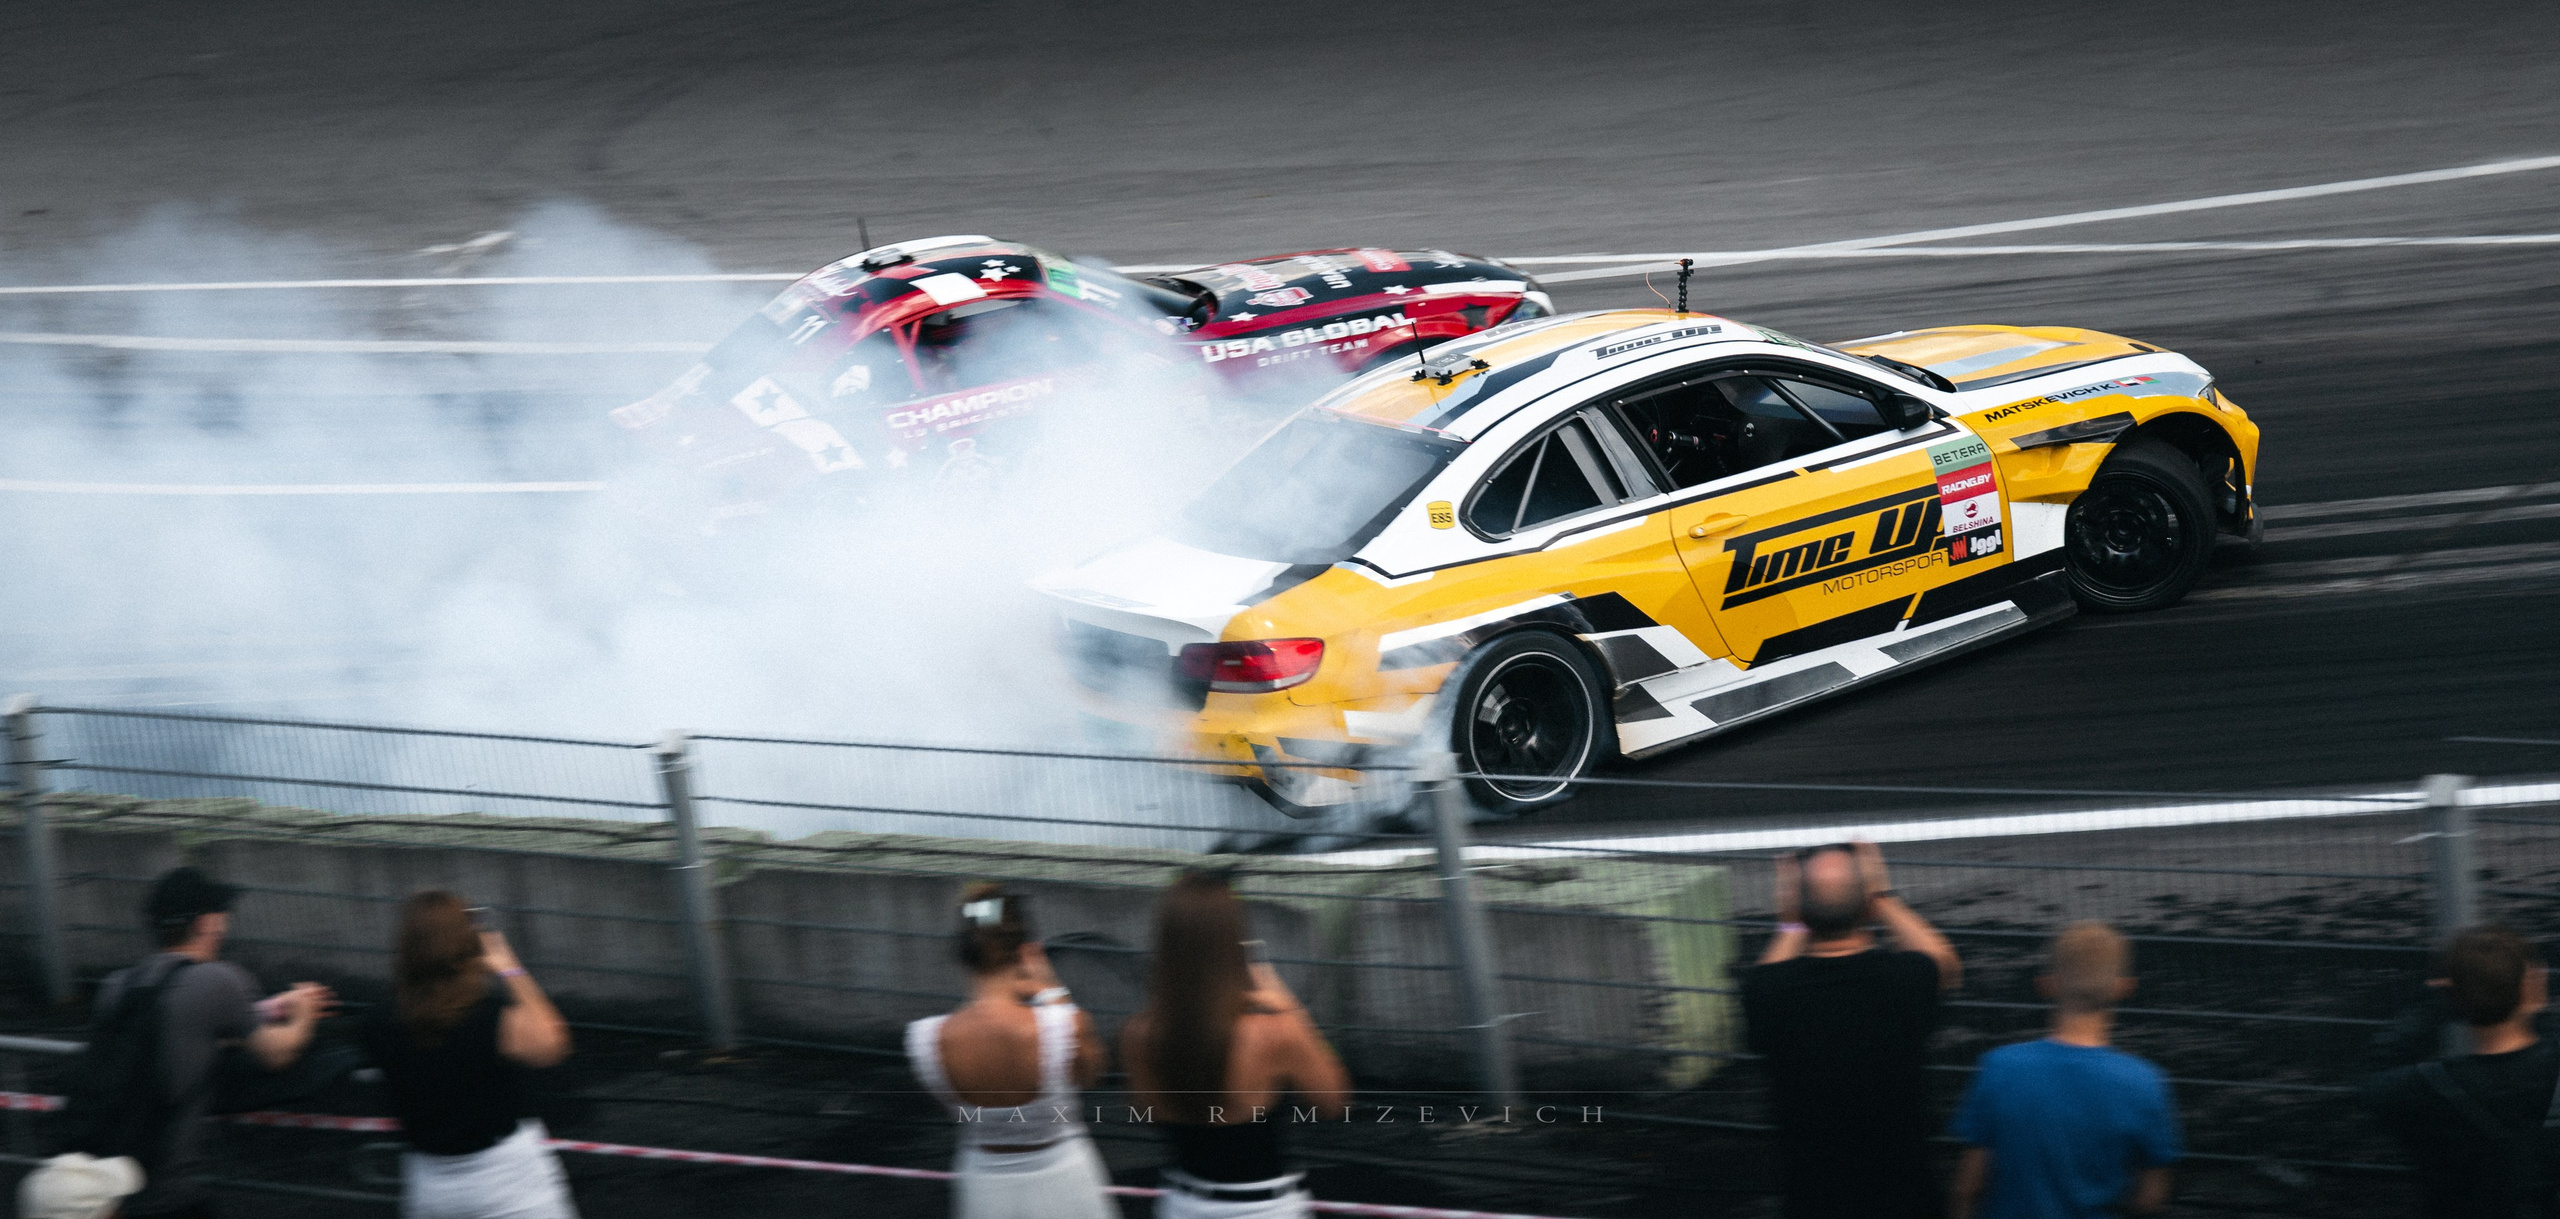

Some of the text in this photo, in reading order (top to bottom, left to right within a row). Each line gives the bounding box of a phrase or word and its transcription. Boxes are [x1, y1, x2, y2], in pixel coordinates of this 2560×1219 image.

[1201, 313, 1418, 363] USA GLOBAL
[1256, 338, 1370, 368] DRIFT TEAM
[886, 378, 1053, 429] CHAMPION
[1984, 382, 2120, 423] MATSKEVICH K.
[1941, 473, 1992, 496] RACING.BY
[1431, 512, 1452, 524] E85
[1952, 516, 1994, 533] BELSHINA
[1823, 550, 1949, 595] MOTORSPOR
